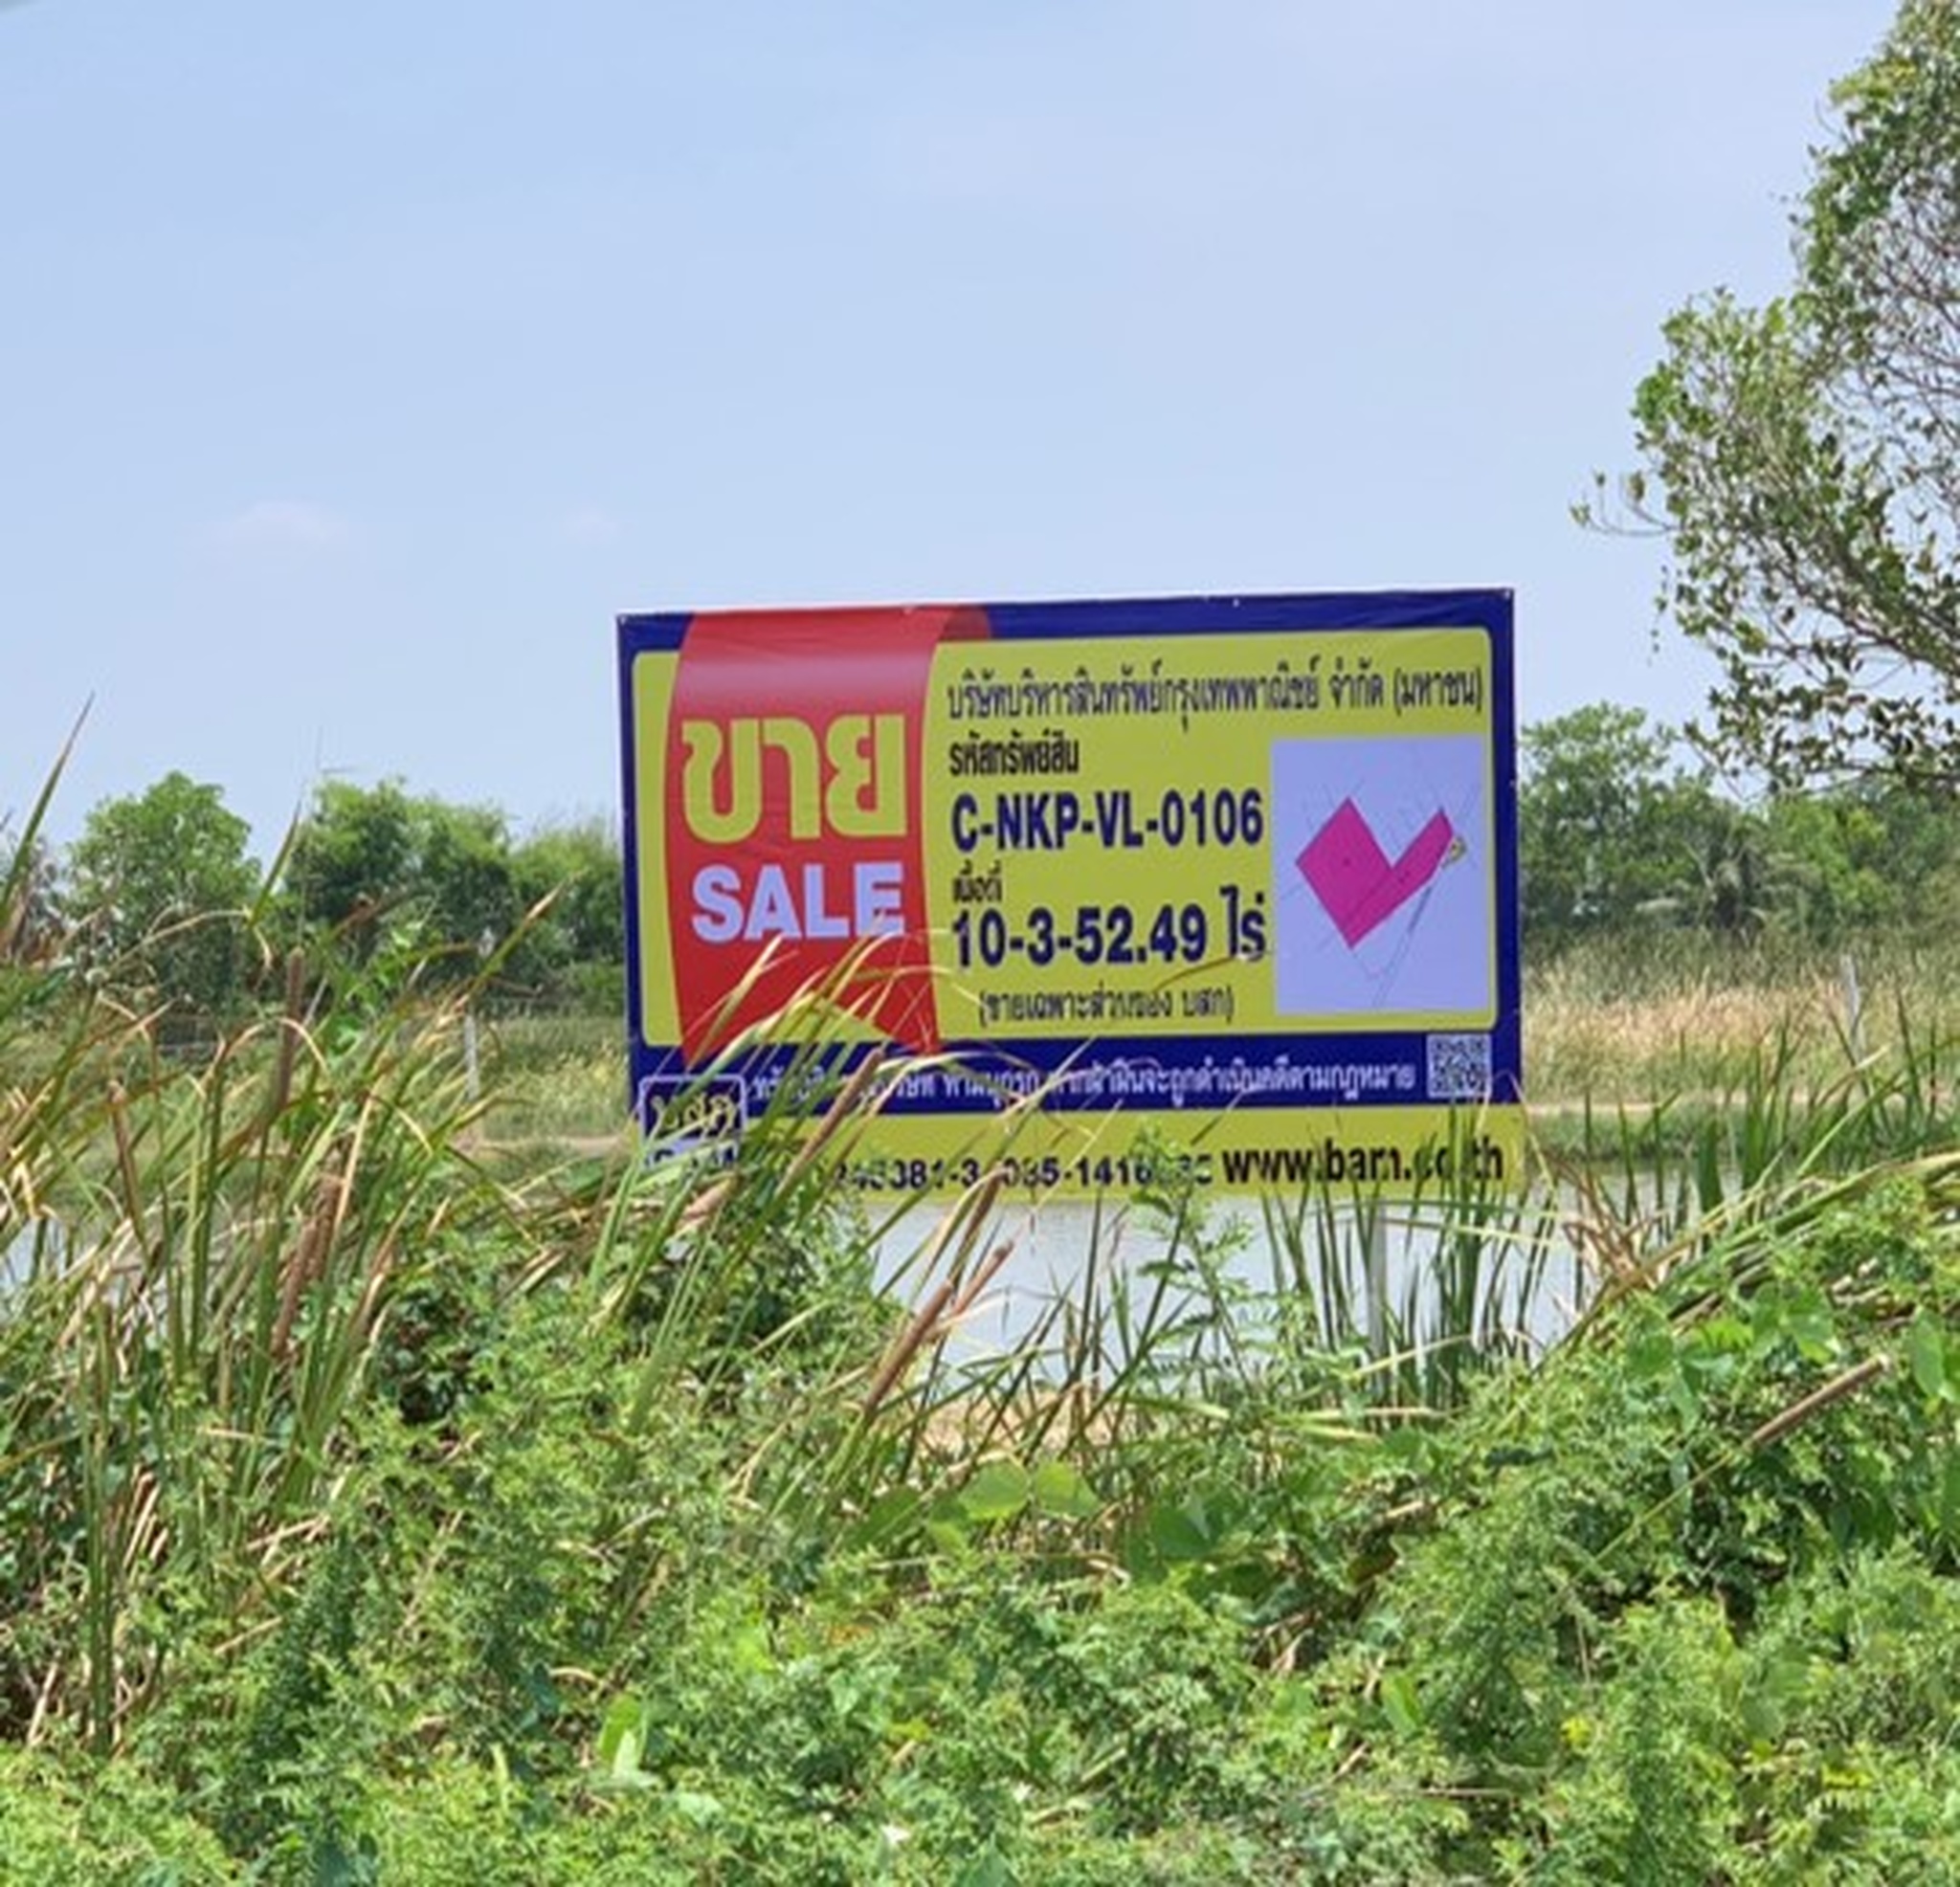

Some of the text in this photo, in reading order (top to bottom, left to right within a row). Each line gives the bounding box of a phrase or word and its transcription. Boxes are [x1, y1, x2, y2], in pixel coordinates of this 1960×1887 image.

[1327, 655, 1385, 711] จำกัด
[1392, 667, 1482, 717] (มหาชน)
[681, 715, 908, 845] ขาย
[948, 727, 1080, 776] รหัสทรัพย์สิน
[950, 786, 1264, 854] C-NKP-VL-0106
[691, 861, 906, 944] SALE
[952, 883, 1267, 967] 10-3-52.49 ไร่
